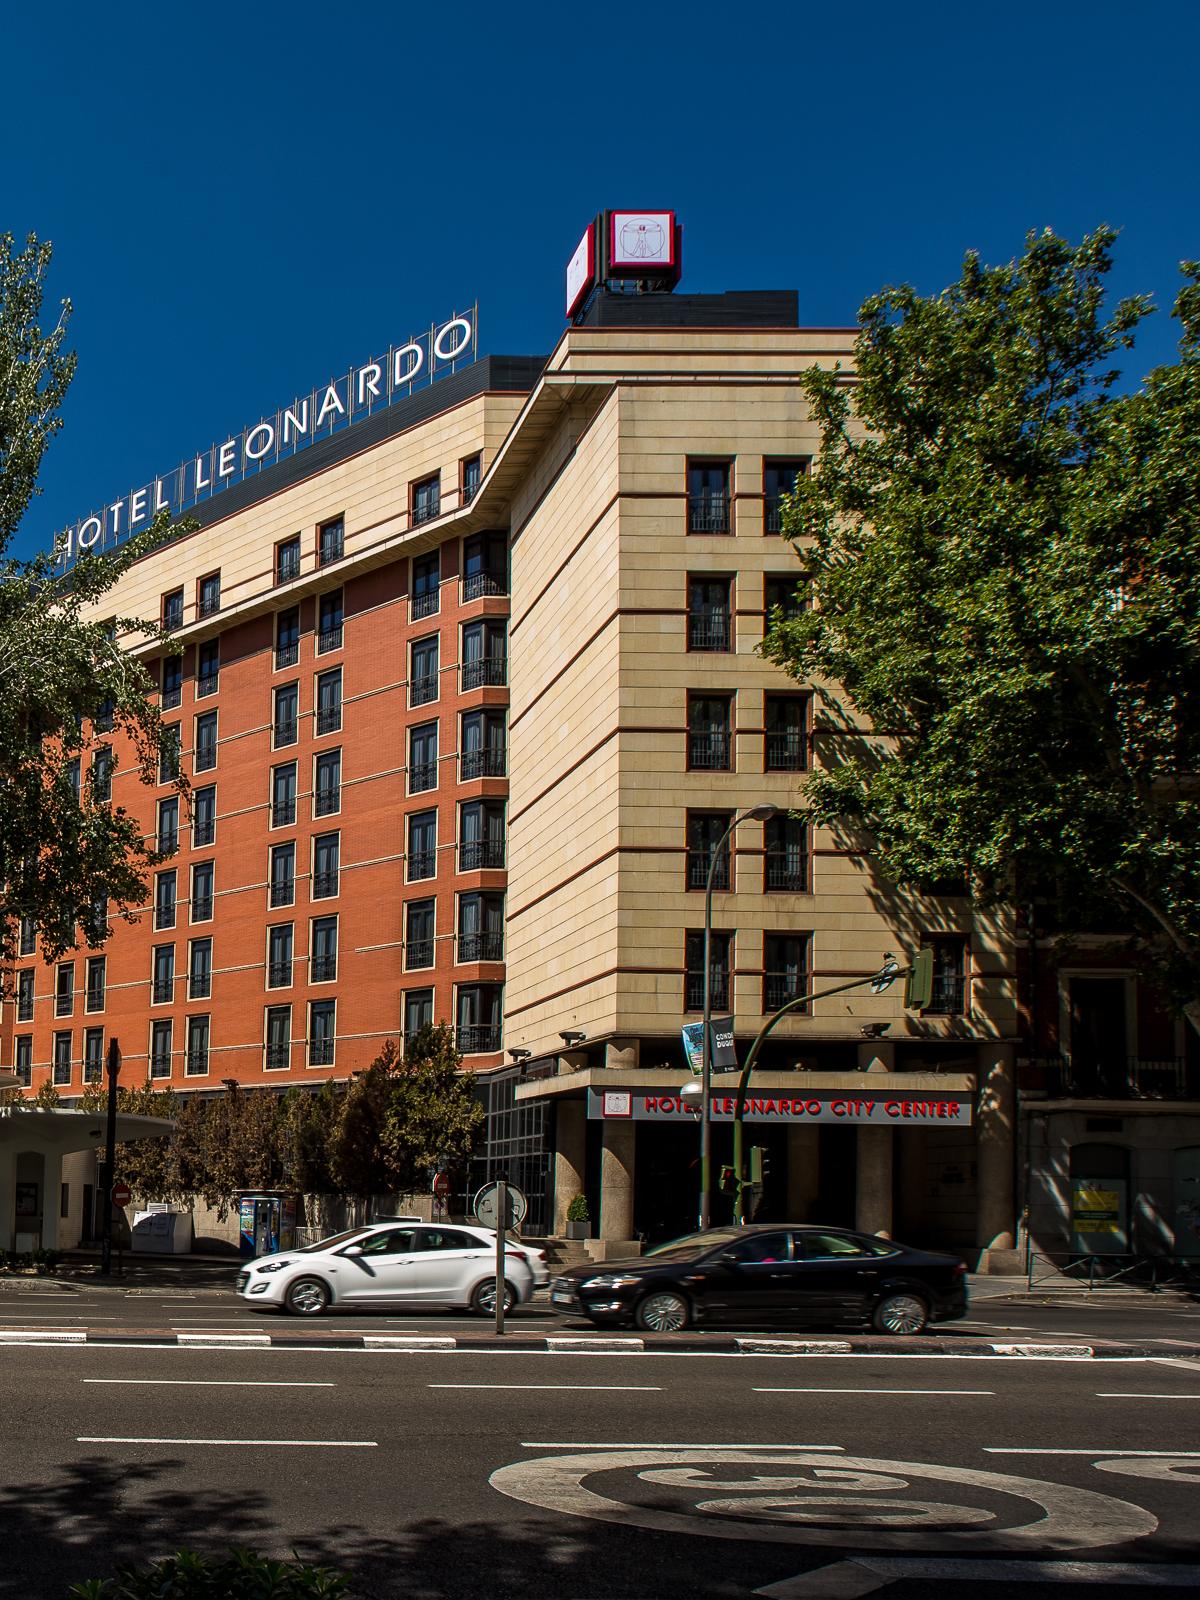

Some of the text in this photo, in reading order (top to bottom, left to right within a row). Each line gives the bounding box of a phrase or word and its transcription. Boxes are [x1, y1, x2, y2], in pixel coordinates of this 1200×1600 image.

[56, 318, 472, 564] HOTEL LEONARDO
[645, 1095, 704, 1114] HOT
[830, 1098, 876, 1117] CITY
[884, 1100, 961, 1119] CENTER
